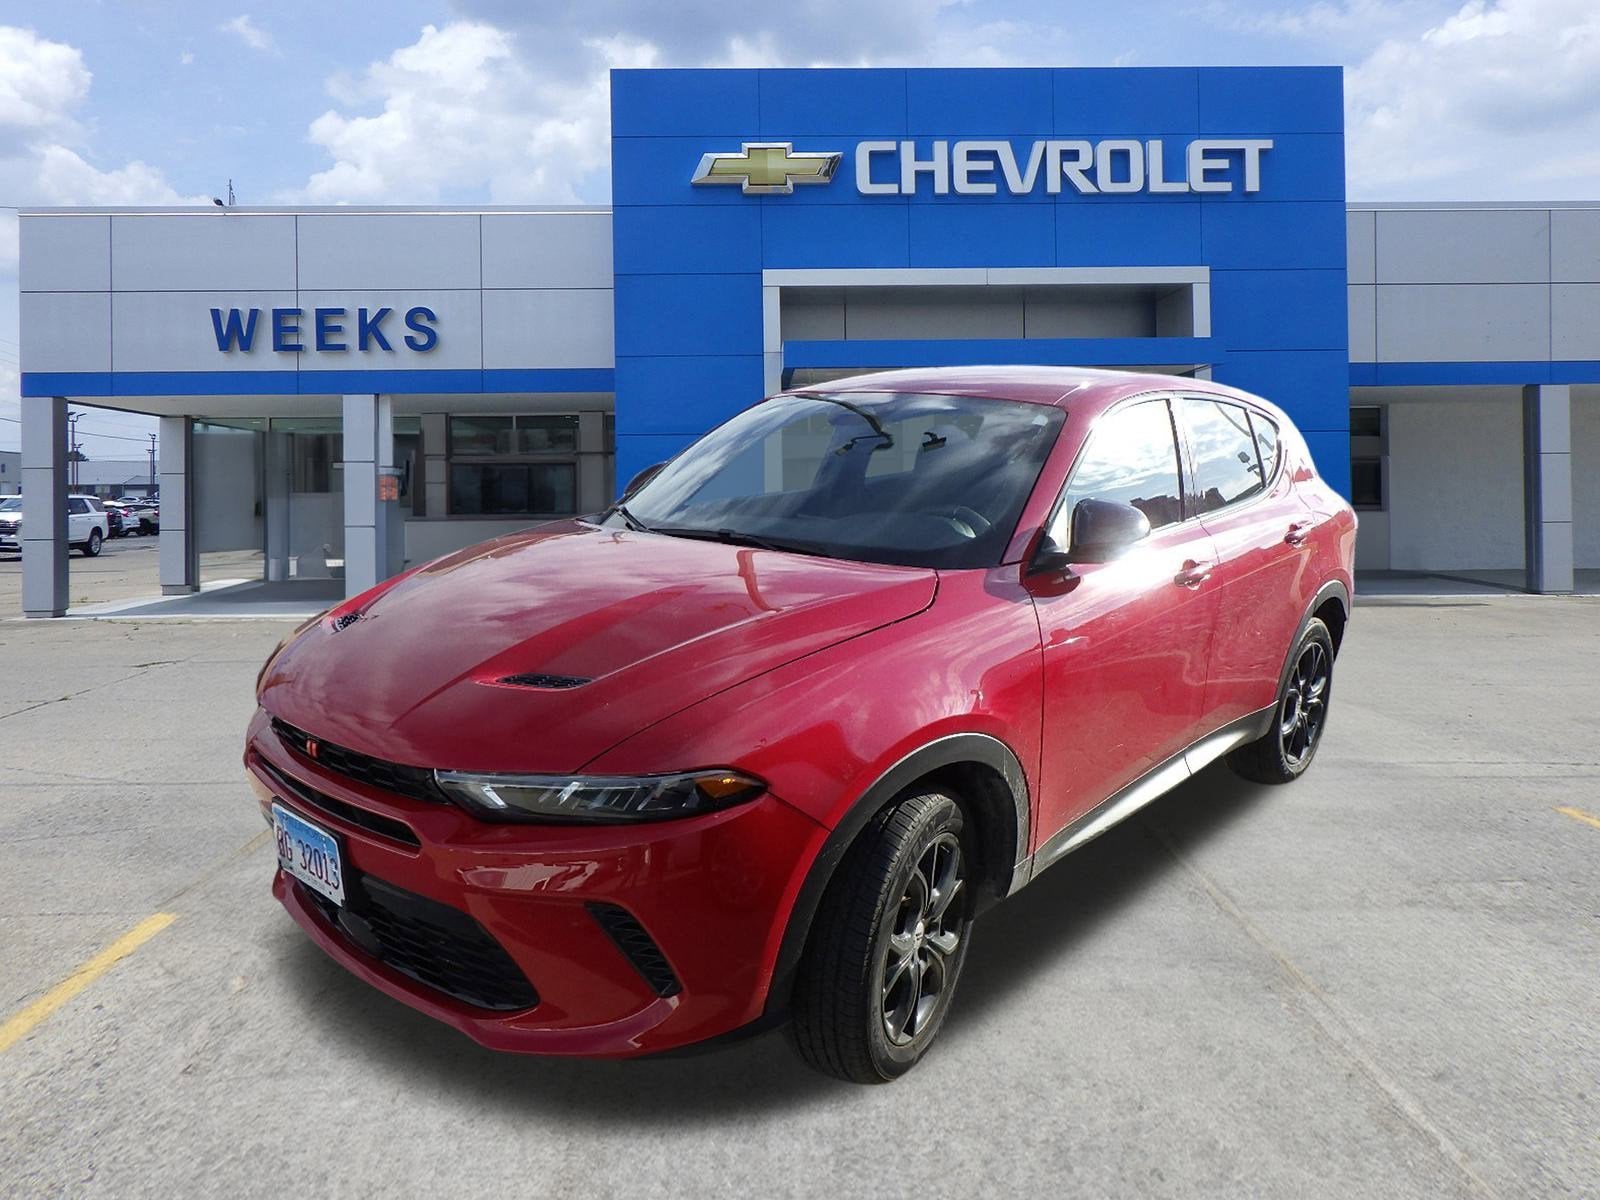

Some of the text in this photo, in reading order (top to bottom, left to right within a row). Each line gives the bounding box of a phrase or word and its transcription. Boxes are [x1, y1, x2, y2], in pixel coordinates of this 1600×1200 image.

[856, 139, 1273, 194] CHEVROLET
[210, 306, 438, 352] WEEKS
[298, 840, 340, 890] 32013
